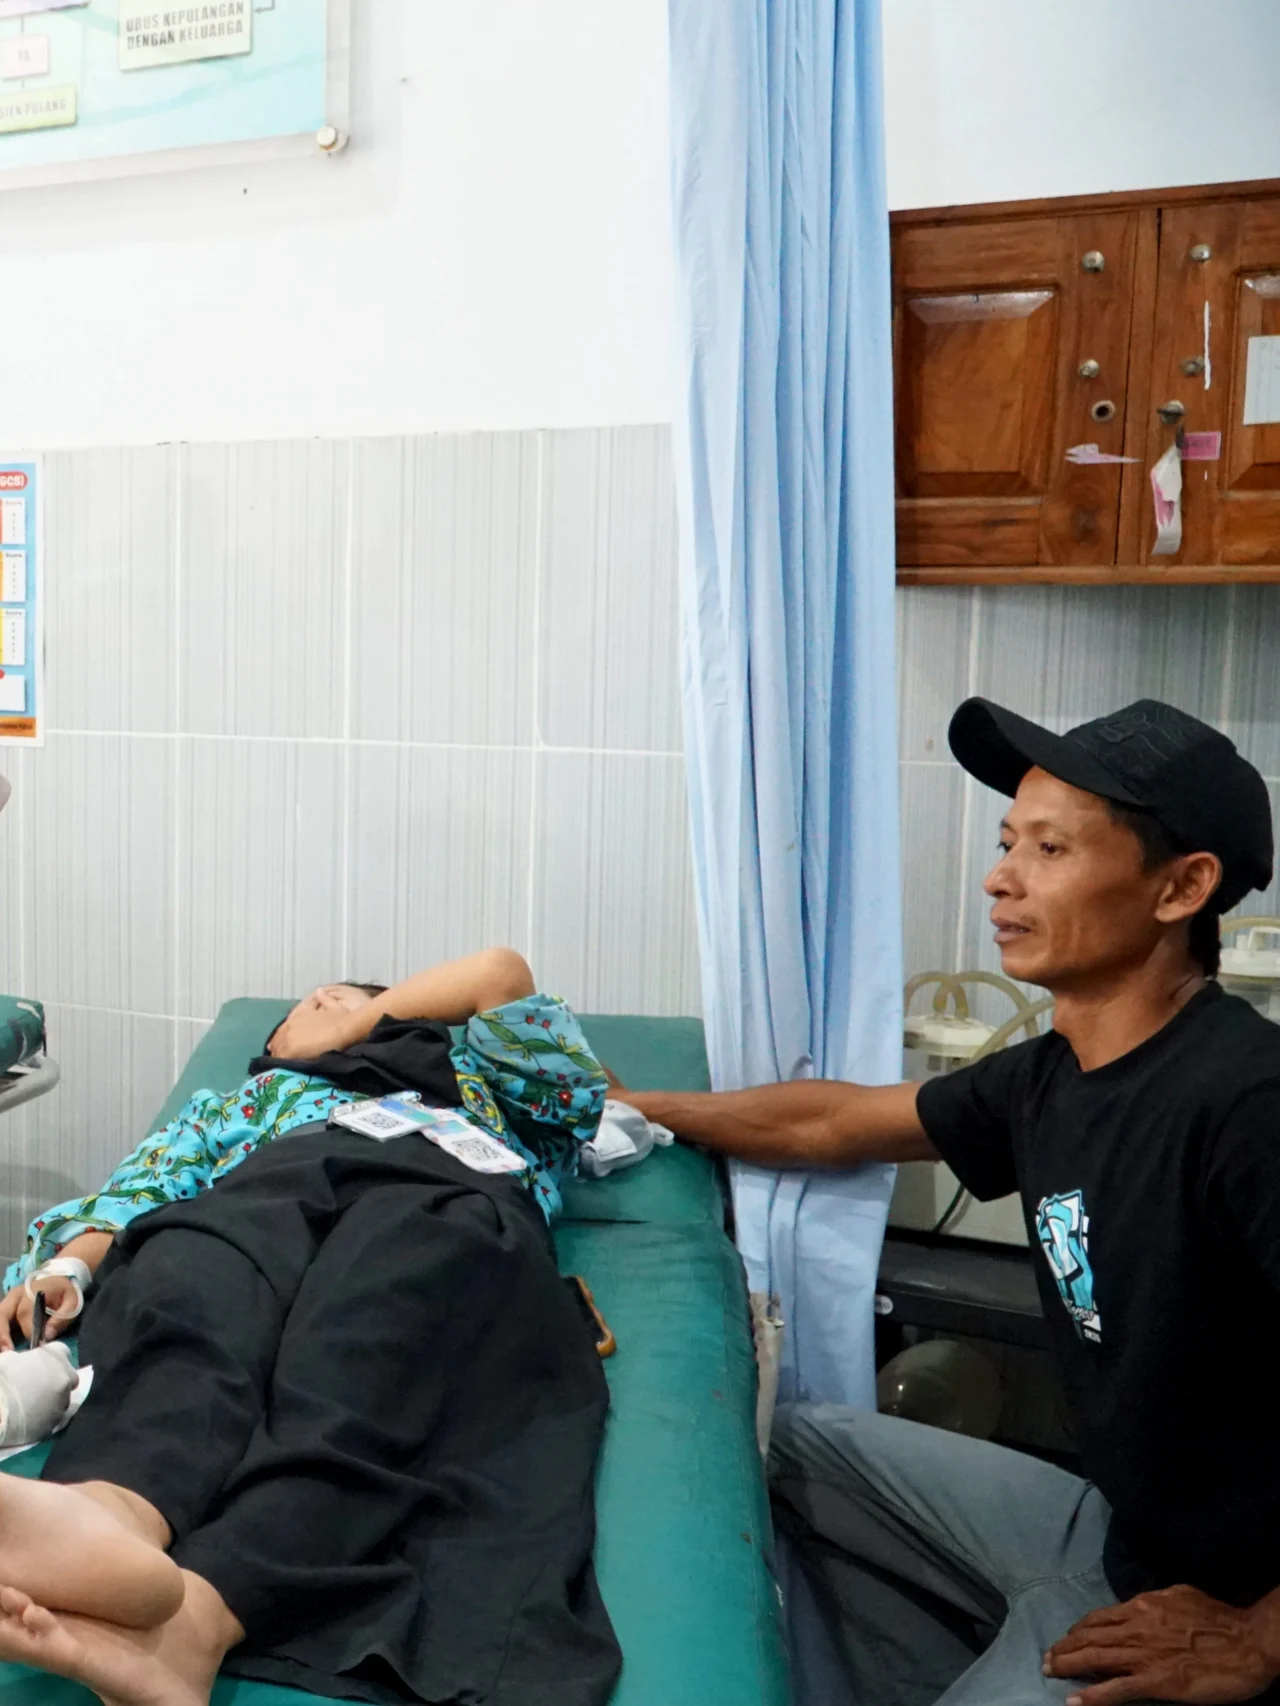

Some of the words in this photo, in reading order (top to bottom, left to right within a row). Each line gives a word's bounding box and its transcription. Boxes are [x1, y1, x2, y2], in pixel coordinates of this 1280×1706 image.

[126, 14, 159, 33] URUS
[163, 1, 244, 27] KEPULANGAN
[127, 30, 176, 50] DENGAN
[179, 19, 243, 43] KELUARGA
[24, 98, 66, 117] PULANG
